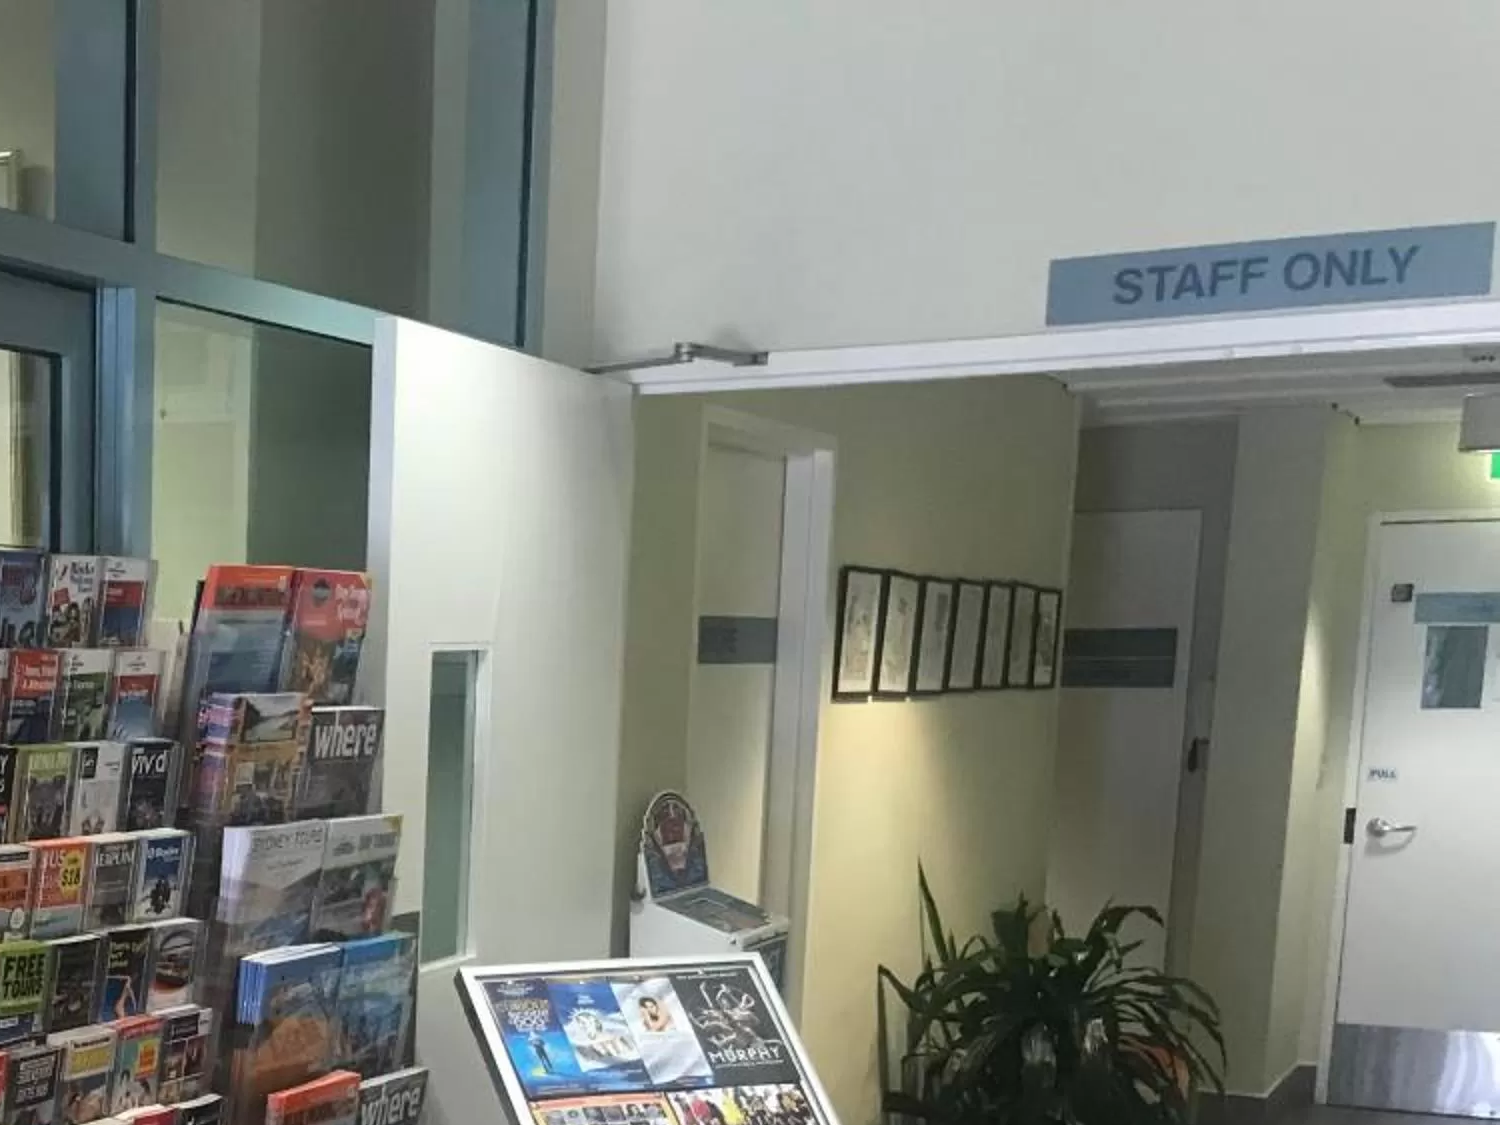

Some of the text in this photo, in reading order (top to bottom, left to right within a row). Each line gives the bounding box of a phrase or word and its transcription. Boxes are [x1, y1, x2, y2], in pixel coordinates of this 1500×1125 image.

[1113, 244, 1421, 305] STAFF ONLY
[314, 710, 377, 760] where
[1368, 768, 1397, 780] PULL
[3, 952, 45, 981] FREE
[3, 977, 44, 1001] TOURS
